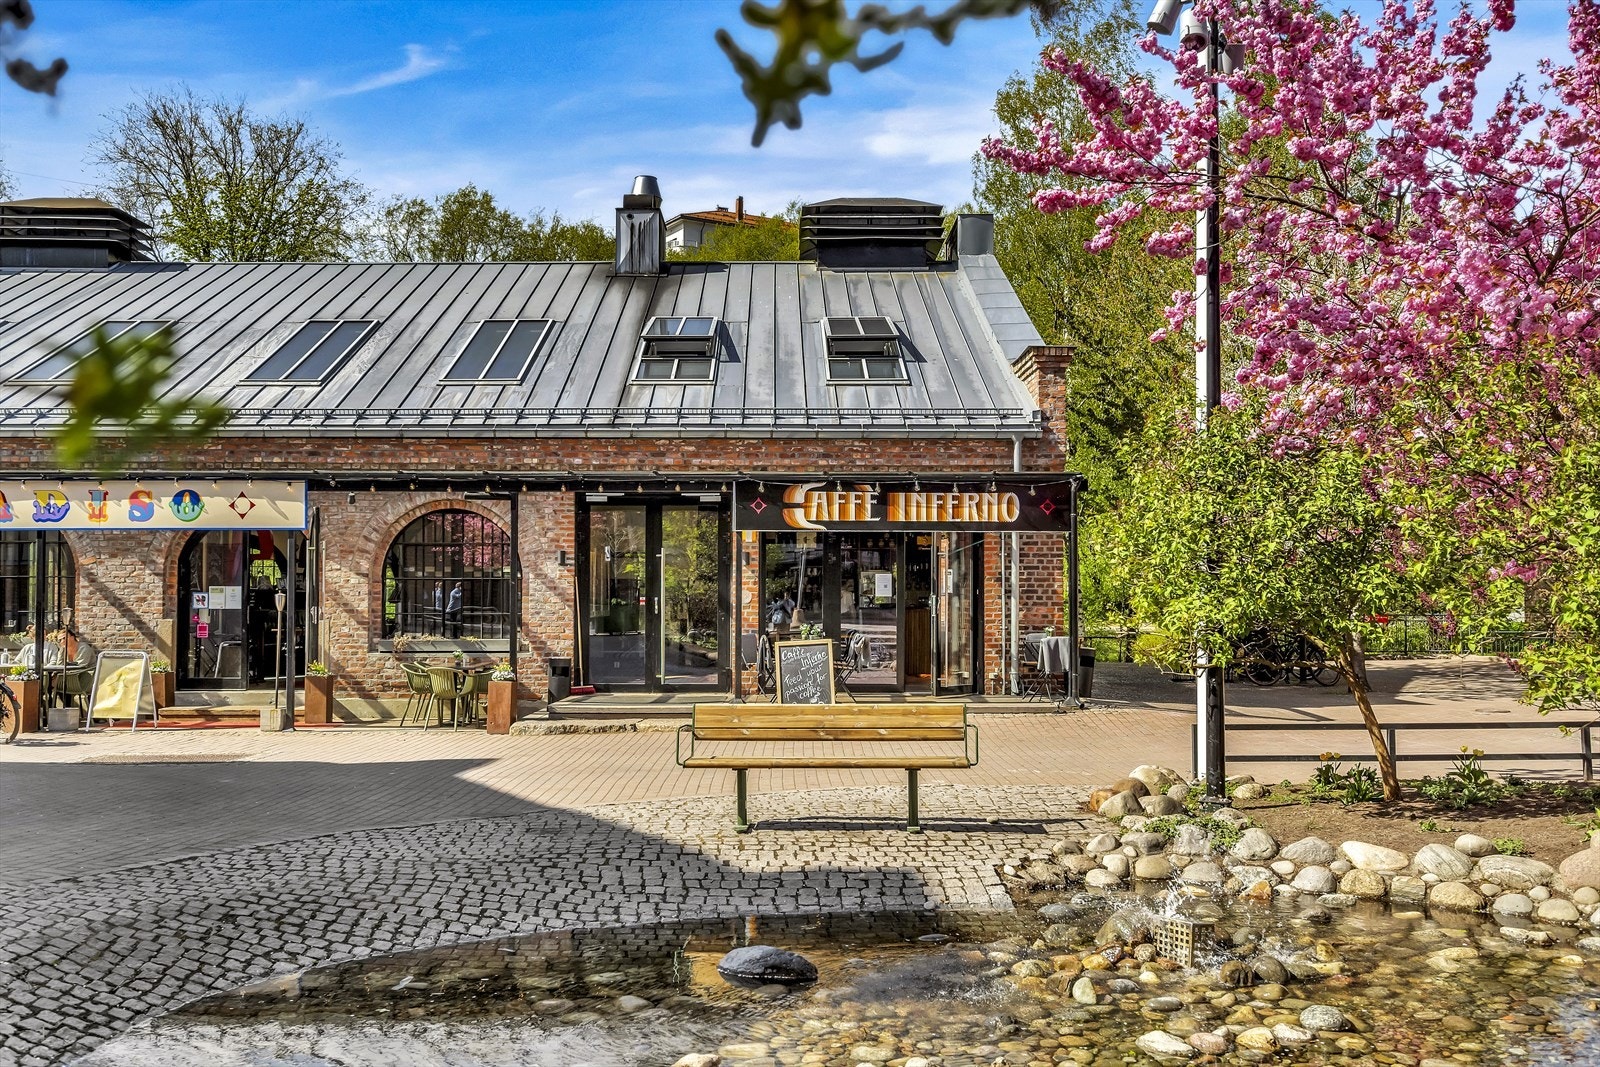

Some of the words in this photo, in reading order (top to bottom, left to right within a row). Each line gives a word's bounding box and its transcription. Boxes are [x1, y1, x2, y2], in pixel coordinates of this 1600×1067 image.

[782, 481, 881, 531] CAFFÈ
[887, 491, 1020, 522] INFERNO
[800, 651, 827, 667] Inferno
[806, 663, 823, 682] your
[785, 680, 813, 701] passion
[816, 672, 828, 685] for
[799, 685, 823, 699] coffee
